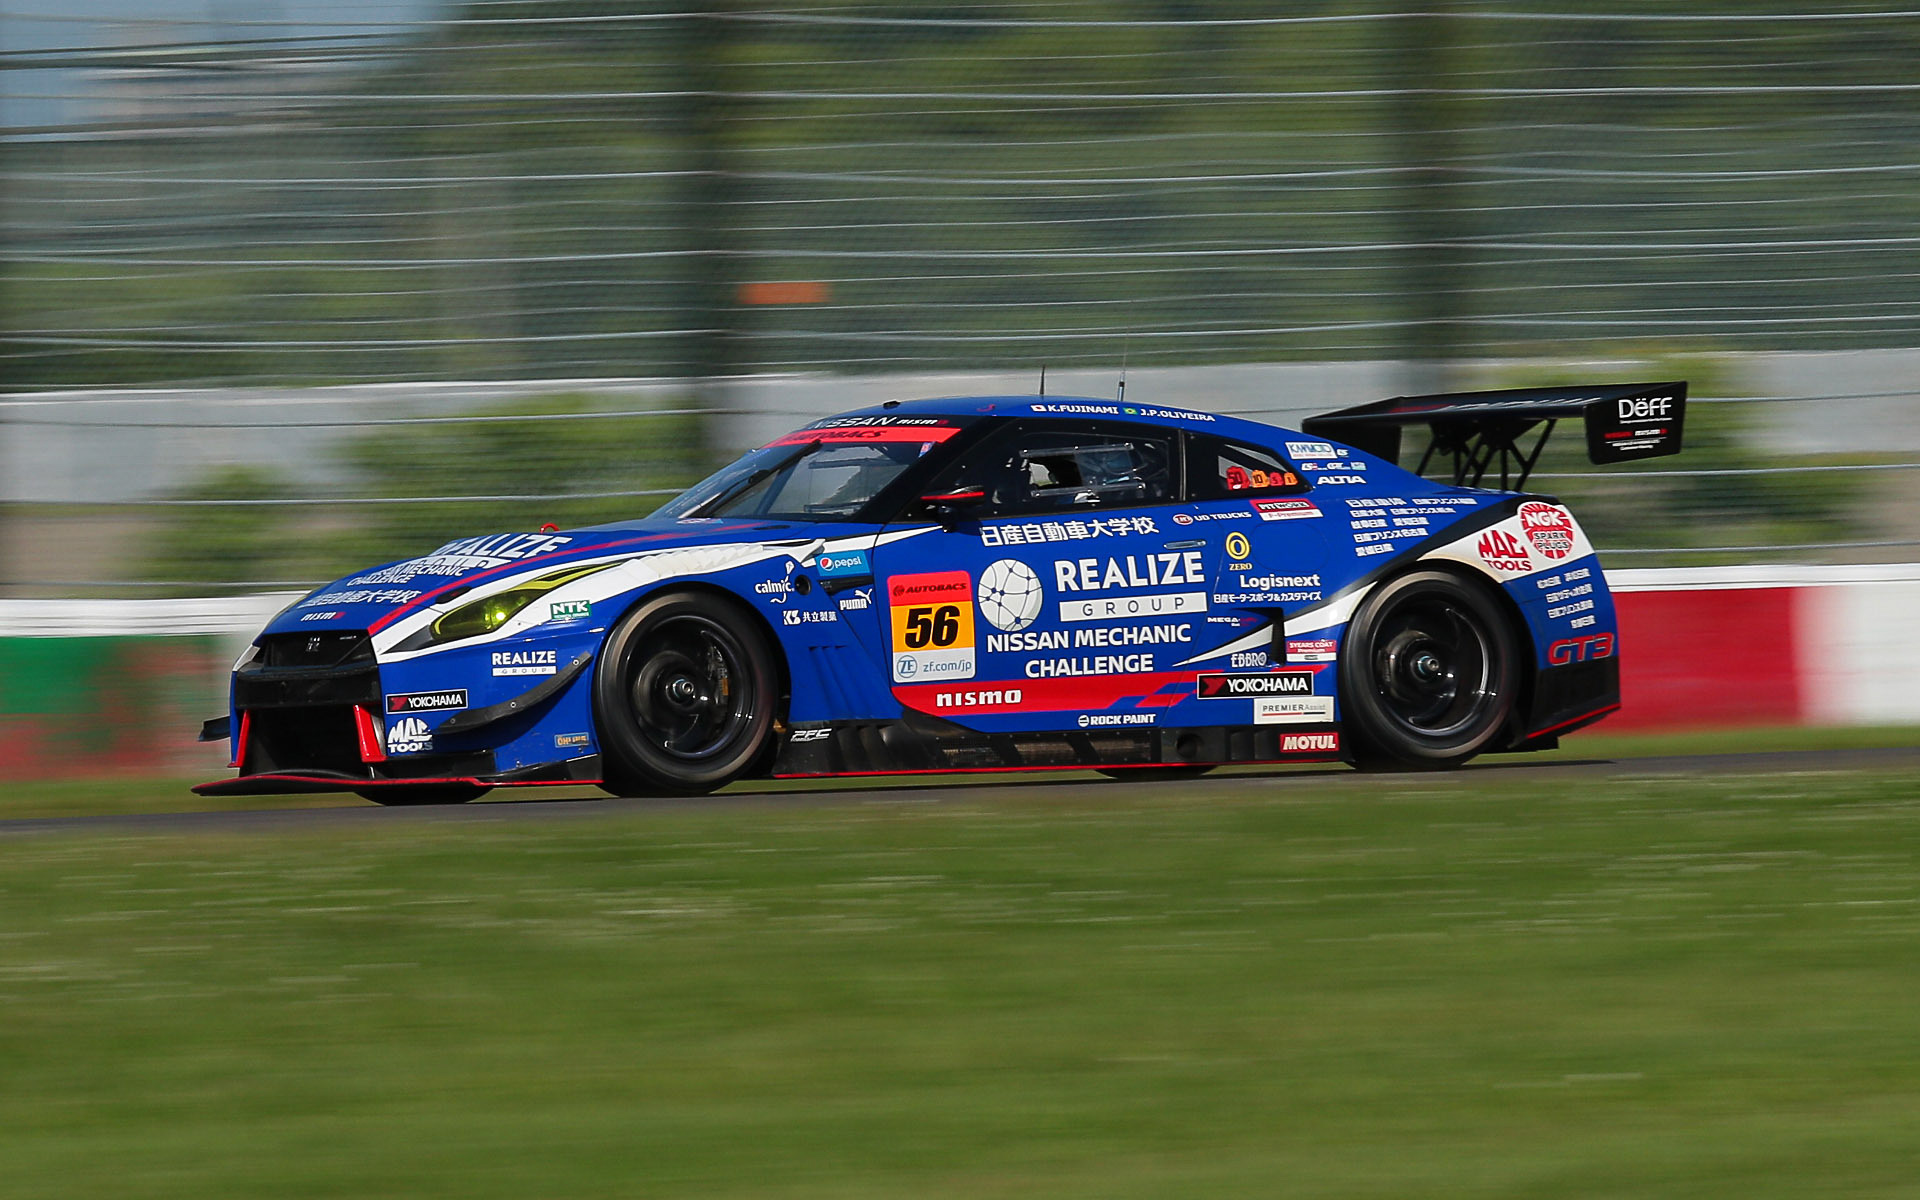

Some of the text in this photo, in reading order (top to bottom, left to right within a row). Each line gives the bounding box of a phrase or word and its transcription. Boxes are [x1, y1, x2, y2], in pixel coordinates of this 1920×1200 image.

[1048, 405, 1216, 422] K.FUJINAMI J.P.OLIVEIRA
[1618, 397, 1673, 418] Dëff
[1210, 511, 1252, 520] TRUCKS
[1524, 511, 1564, 527] NGK
[981, 516, 1160, 547] 日産自動車大学校
[1533, 532, 1566, 540] SPARK
[1478, 530, 1529, 558] MAC
[834, 556, 862, 569] pepsi
[1229, 563, 1253, 571] ZERO
[1483, 560, 1532, 571] TOOLS
[1054, 552, 1206, 592] REALIZE
[905, 583, 967, 593] AUTOBACS
[1240, 574, 1321, 591] Logisnext
[552, 601, 588, 615] NTK
[1082, 597, 1185, 616] GROUP
[904, 605, 960, 648] 56
[986, 624, 1192, 653] NISSAN MECHANIC
[1548, 632, 1615, 666] GT3
[492, 651, 556, 666] REALIZE
[923, 659, 972, 673] zf.com/jp
[1025, 654, 1154, 678] CHALLENGE
[1231, 652, 1267, 667] EBBRO
[501, 667, 547, 675] GROUP
[1227, 678, 1308, 692] YOKOHAMA
[408, 694, 463, 708] YOKOHAMA
[936, 689, 1022, 707] nismo
[1090, 713, 1156, 726] ROCK PAINT
[387, 718, 433, 743] MAC
[1283, 735, 1336, 750] MOTUL
